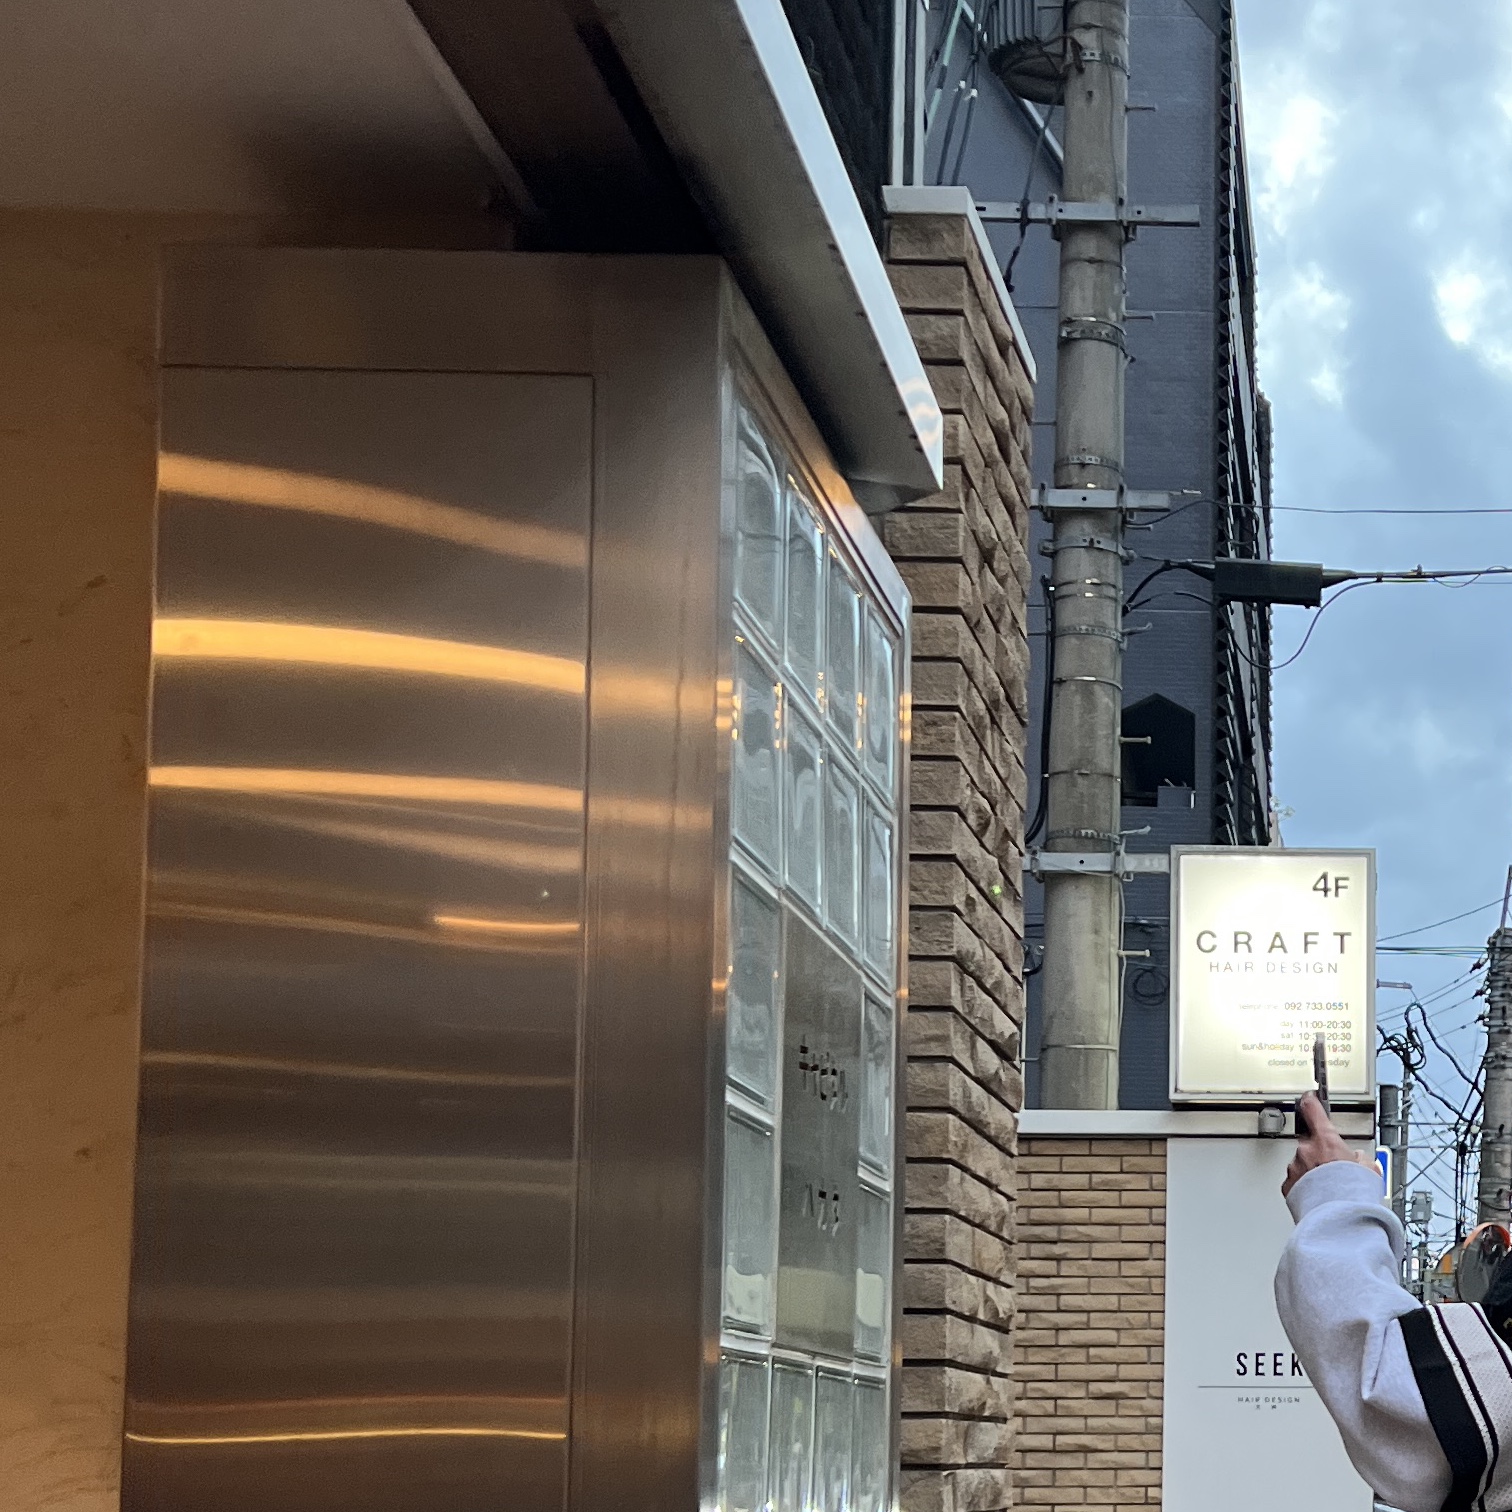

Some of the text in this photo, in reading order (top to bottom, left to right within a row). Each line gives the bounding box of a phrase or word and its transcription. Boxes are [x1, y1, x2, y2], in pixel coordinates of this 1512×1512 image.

[1312, 871, 1350, 898] 4F
[1196, 930, 1352, 954] CRAFT
[1209, 961, 1338, 974] HAIR DESIGN
[1236, 1352, 1304, 1377] SEEK
